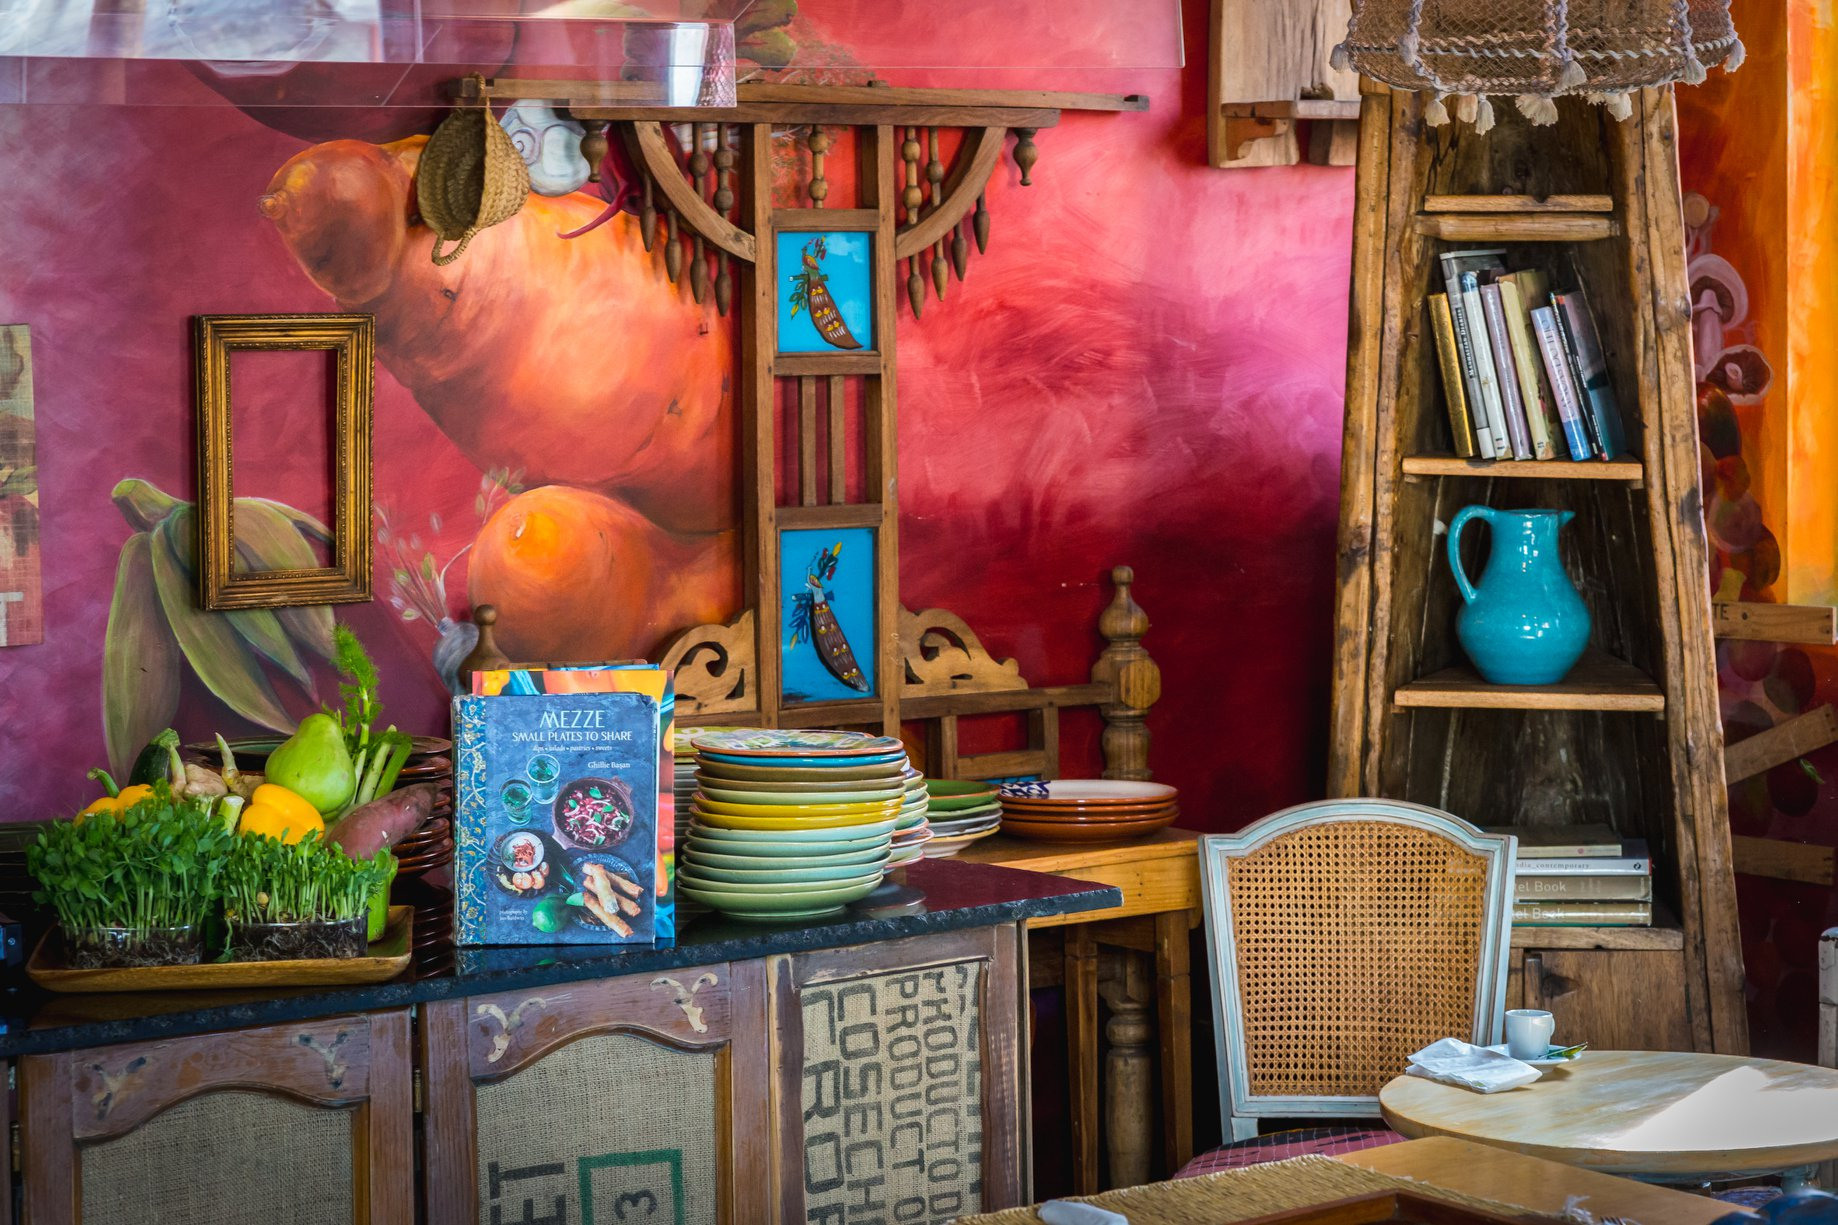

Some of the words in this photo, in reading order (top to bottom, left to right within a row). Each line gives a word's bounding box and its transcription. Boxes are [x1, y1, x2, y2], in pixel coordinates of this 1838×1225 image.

[540, 710, 605, 728] MEZZE
[512, 731, 545, 742] SMALL
[547, 731, 582, 742] PLATES
[583, 731, 599, 742] TO
[601, 730, 633, 742] SHARE
[569, 745, 591, 753] pastries
[587, 761, 610, 769] Ghillie
[1534, 880, 1567, 892] Book
[1532, 907, 1565, 920] Book
[884, 975, 926, 1174] PRODUCT
[837, 983, 887, 1225] COSECH
